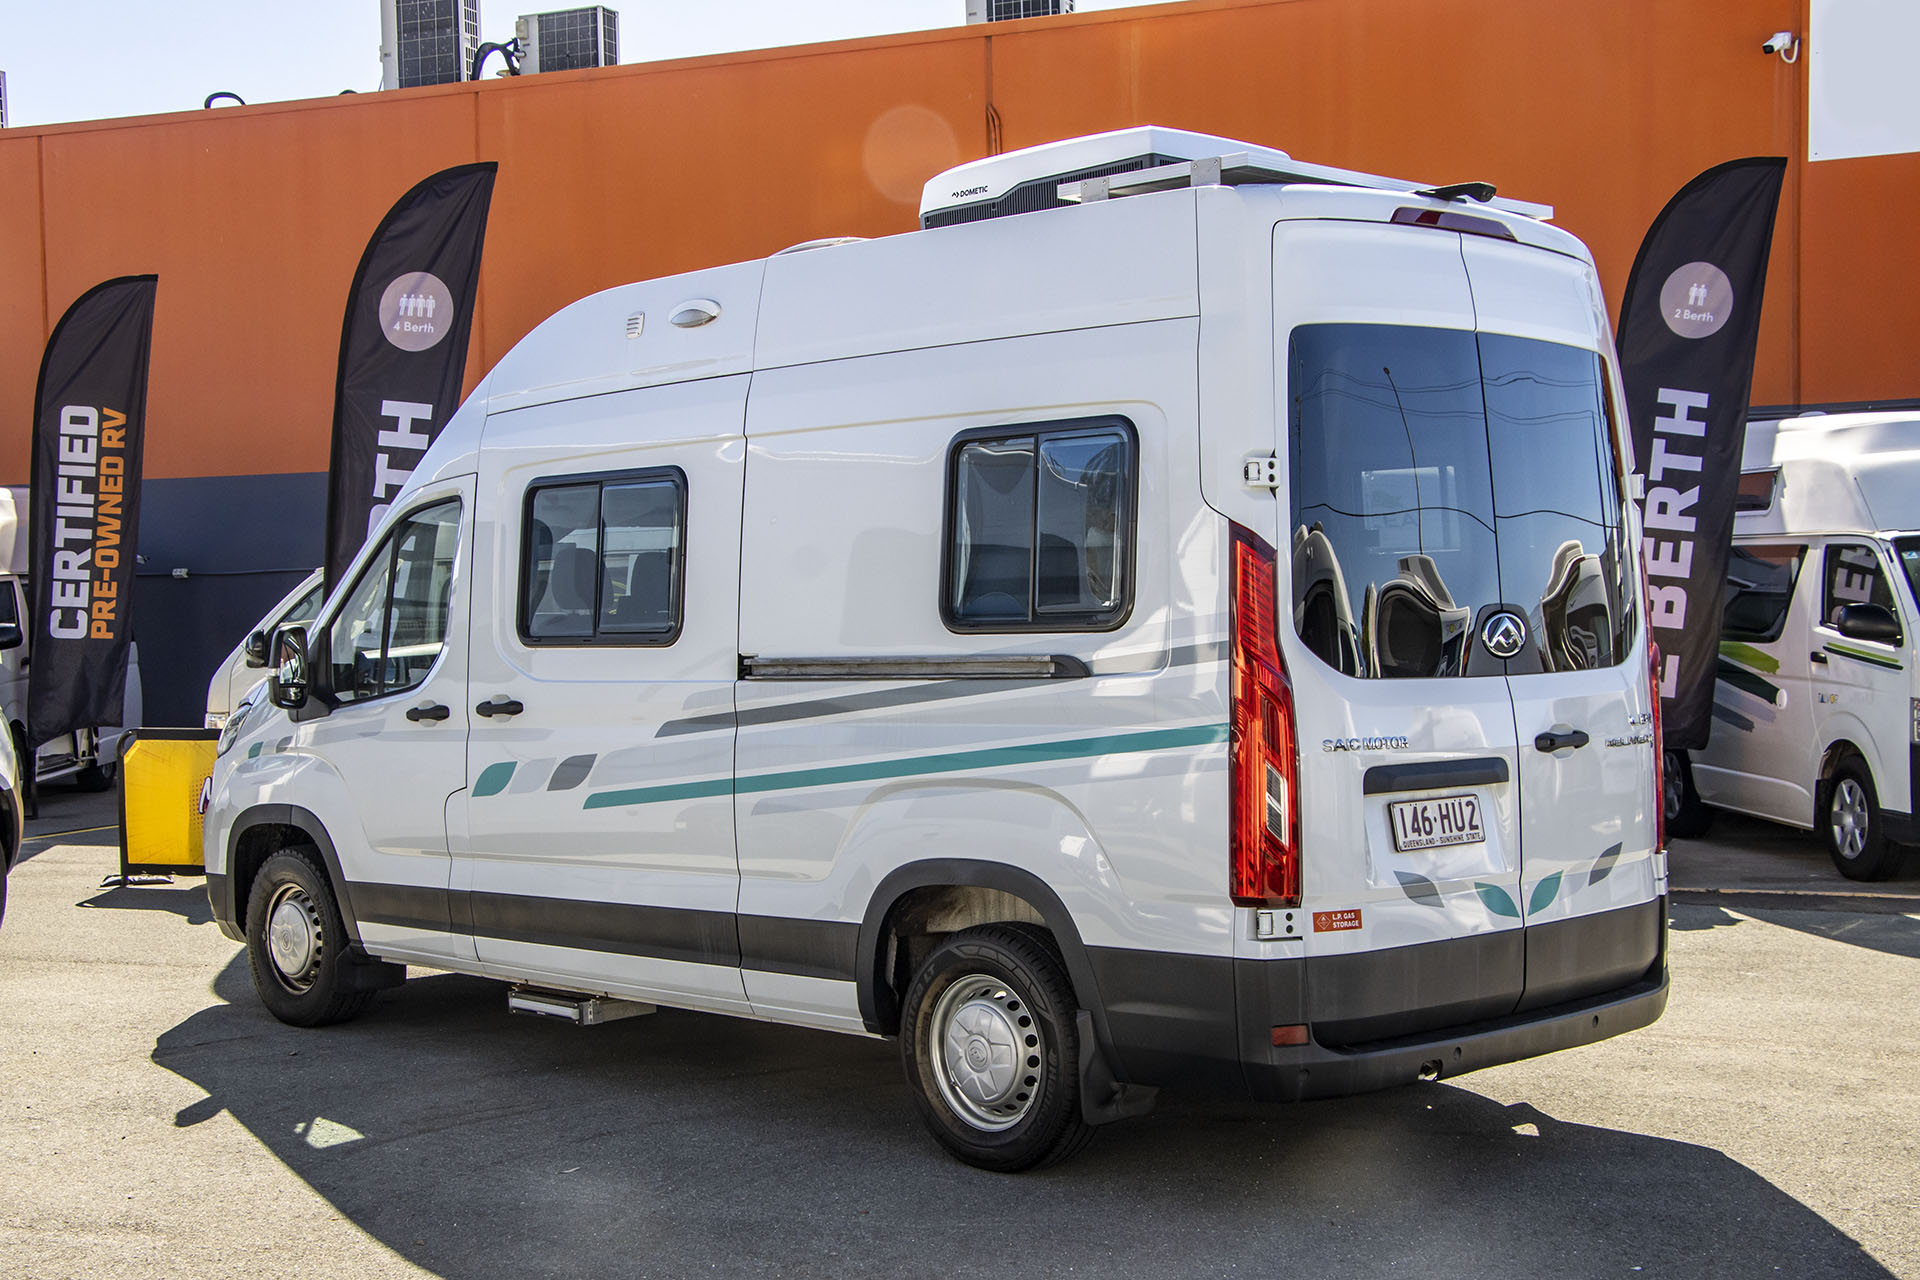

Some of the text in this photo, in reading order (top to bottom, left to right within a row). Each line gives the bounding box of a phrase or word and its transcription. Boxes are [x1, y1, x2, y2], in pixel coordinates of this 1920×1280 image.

[959, 185, 989, 198] DOMETIC
[1674, 308, 1714, 322] 2 Berth
[393, 321, 435, 334] 4 Berth
[1643, 387, 1710, 630] BERTH
[49, 405, 98, 640] CERTIFIED
[90, 407, 127, 640] PRE-OWNED RV
[1322, 735, 1409, 753] SAIC MOTOR
[1402, 837, 1436, 849] QUEENSLAND
[1440, 833, 1465, 844] SUNSHINE
[1465, 832, 1482, 841] STATE
[1343, 912, 1356, 920] GAS
[1332, 920, 1359, 929] STORAGE
